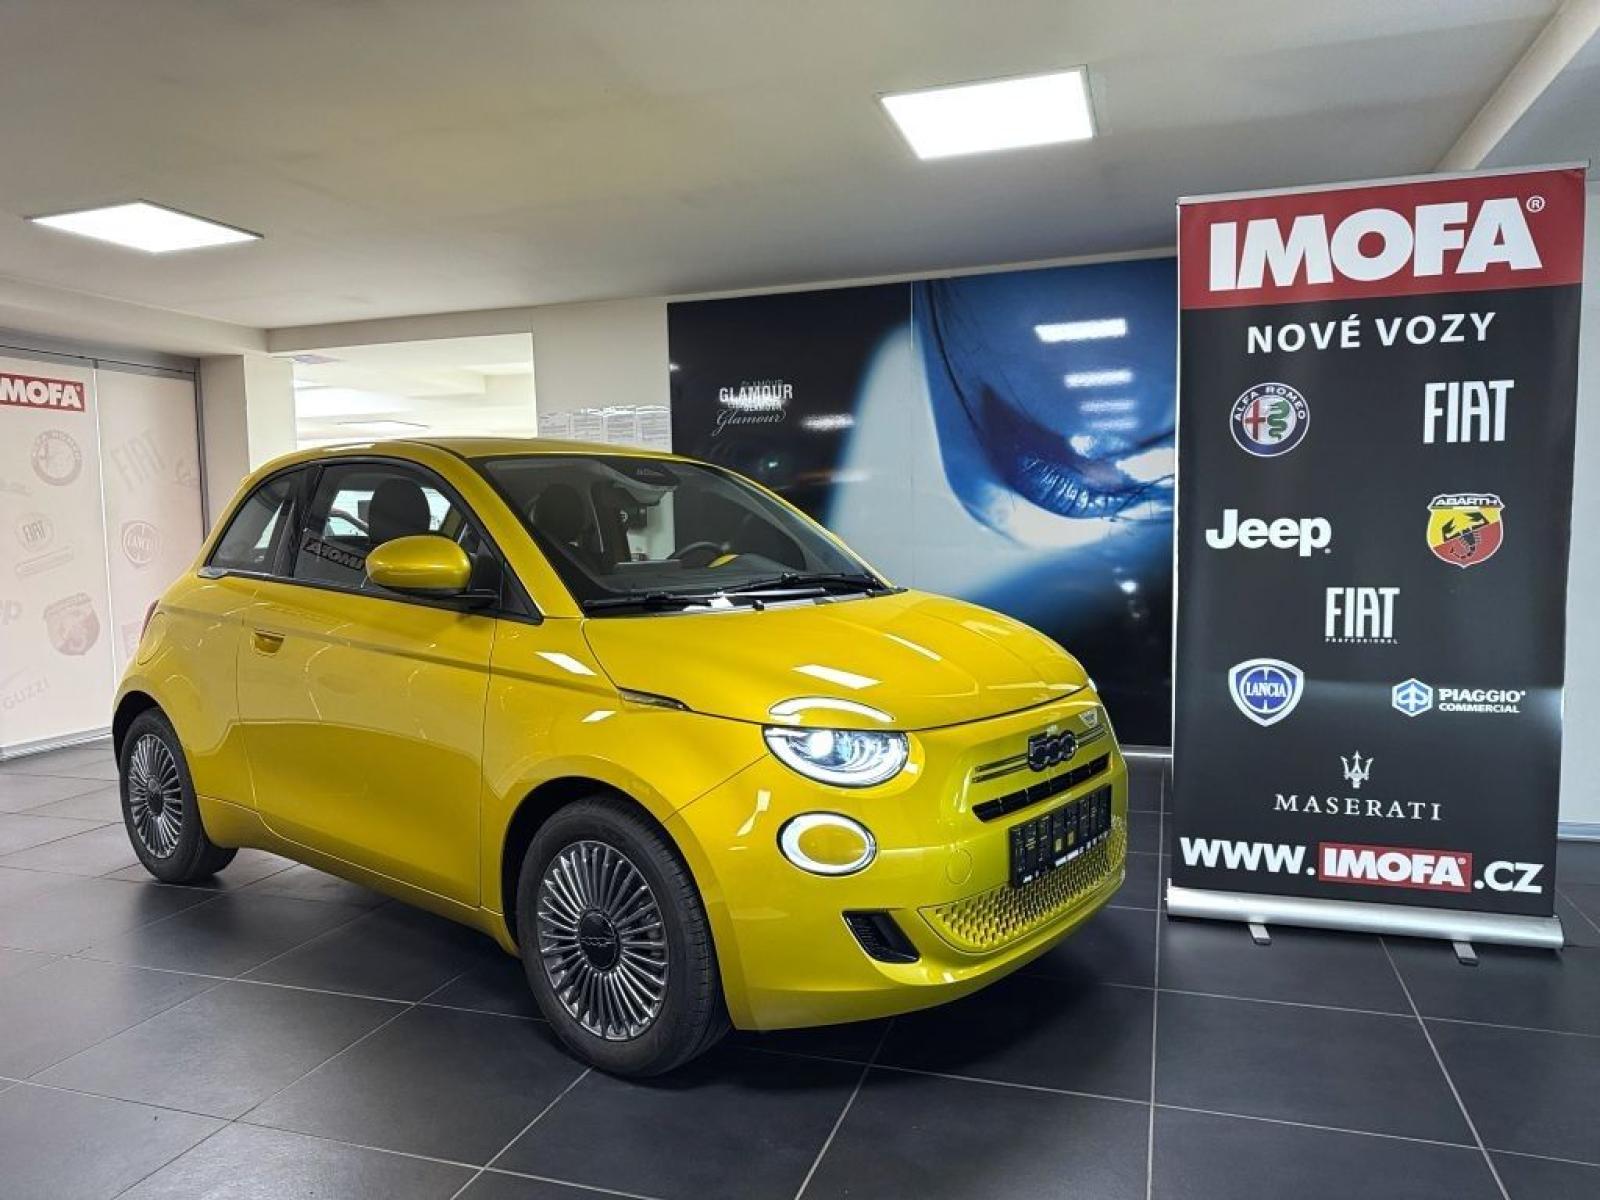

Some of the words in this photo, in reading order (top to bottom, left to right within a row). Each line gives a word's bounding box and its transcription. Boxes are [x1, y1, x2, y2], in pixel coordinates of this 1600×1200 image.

[1247, 313, 1361, 354] NOVÉ
[1375, 312, 1496, 347] VOZY
[719, 383, 793, 403] GLAMOUR
[1234, 391, 1259, 421] ALFA
[1265, 386, 1306, 420] ROMEO
[1423, 380, 1514, 443] FIAT
[1435, 497, 1498, 506] ABARTH
[1205, 508, 1332, 557] Jeep
[1325, 587, 1400, 638] FIAT
[1246, 682, 1287, 698] LANCIA
[1438, 702, 1521, 713] COMMERCIAL
[1274, 793, 1443, 821] MASERATI
